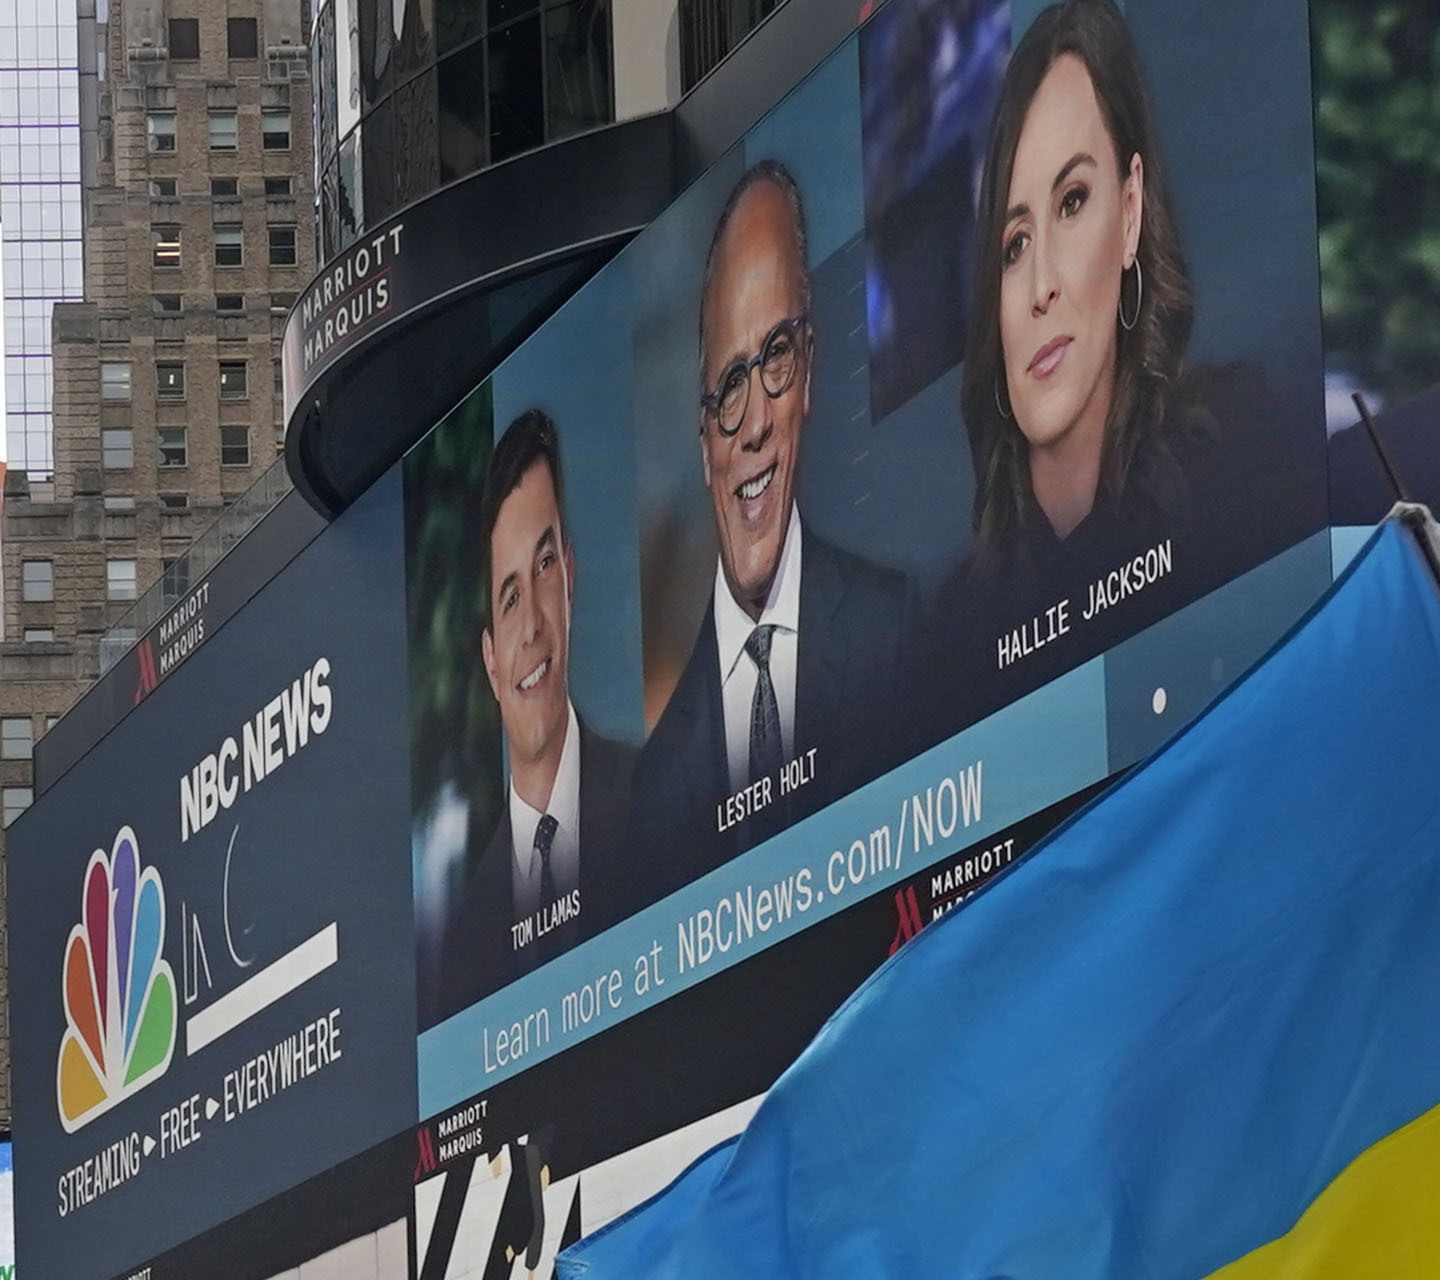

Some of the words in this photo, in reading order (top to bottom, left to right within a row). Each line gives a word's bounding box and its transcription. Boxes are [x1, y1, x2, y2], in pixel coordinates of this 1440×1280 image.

[303, 224, 404, 329] MARRIOTT
[304, 278, 389, 370] MARQUIS
[160, 582, 209, 645] MARRIOTT
[161, 619, 203, 673] MARQUIS
[997, 600, 1071, 670] HALLIE
[1083, 539, 1174, 621] JACKSON
[180, 736, 238, 842] NBC
[243, 657, 332, 792] NEWS
[717, 781, 772, 833] LESTER
[780, 749, 818, 797] HOLT
[931, 839, 1014, 898] MARRIOTT
[483, 1010, 549, 1074] Learn
[562, 963, 623, 1031] more
[634, 943, 665, 989] at
[677, 760, 984, 974] NBCNews.com/NOW
[511, 917, 534, 951] TOM
[536, 895, 581, 941] LLAMAS
[58, 1134, 141, 1218] STREAMING
[160, 1094, 201, 1159] FREE
[223, 1007, 343, 1123] EVERYWHERE
[439, 1100, 487, 1138] MARRIOTT
[439, 1127, 483, 1161] MARQUIS
